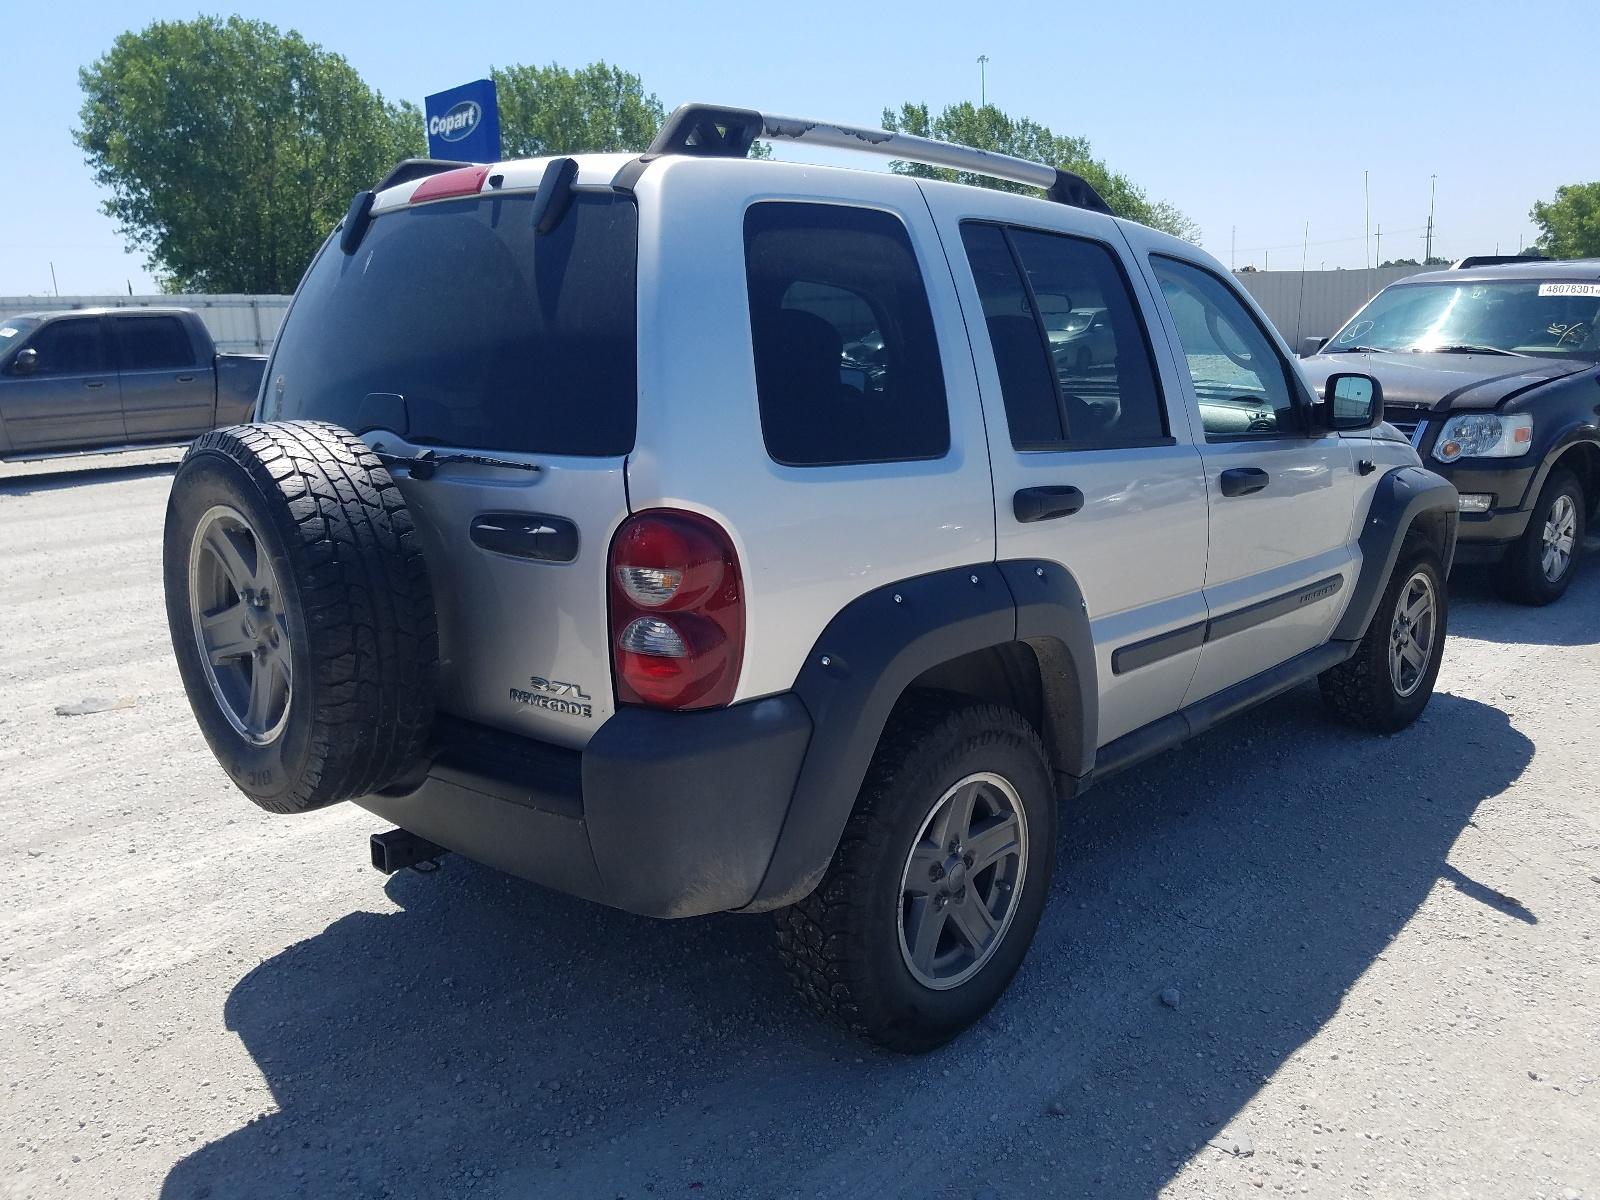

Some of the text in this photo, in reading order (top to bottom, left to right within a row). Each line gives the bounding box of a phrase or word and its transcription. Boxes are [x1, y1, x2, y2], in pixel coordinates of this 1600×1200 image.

[429, 104, 476, 137] Copart
[1546, 285, 1595, 294] 48078301
[530, 676, 592, 700] 3.7L
[509, 688, 592, 718] RENEGADE
